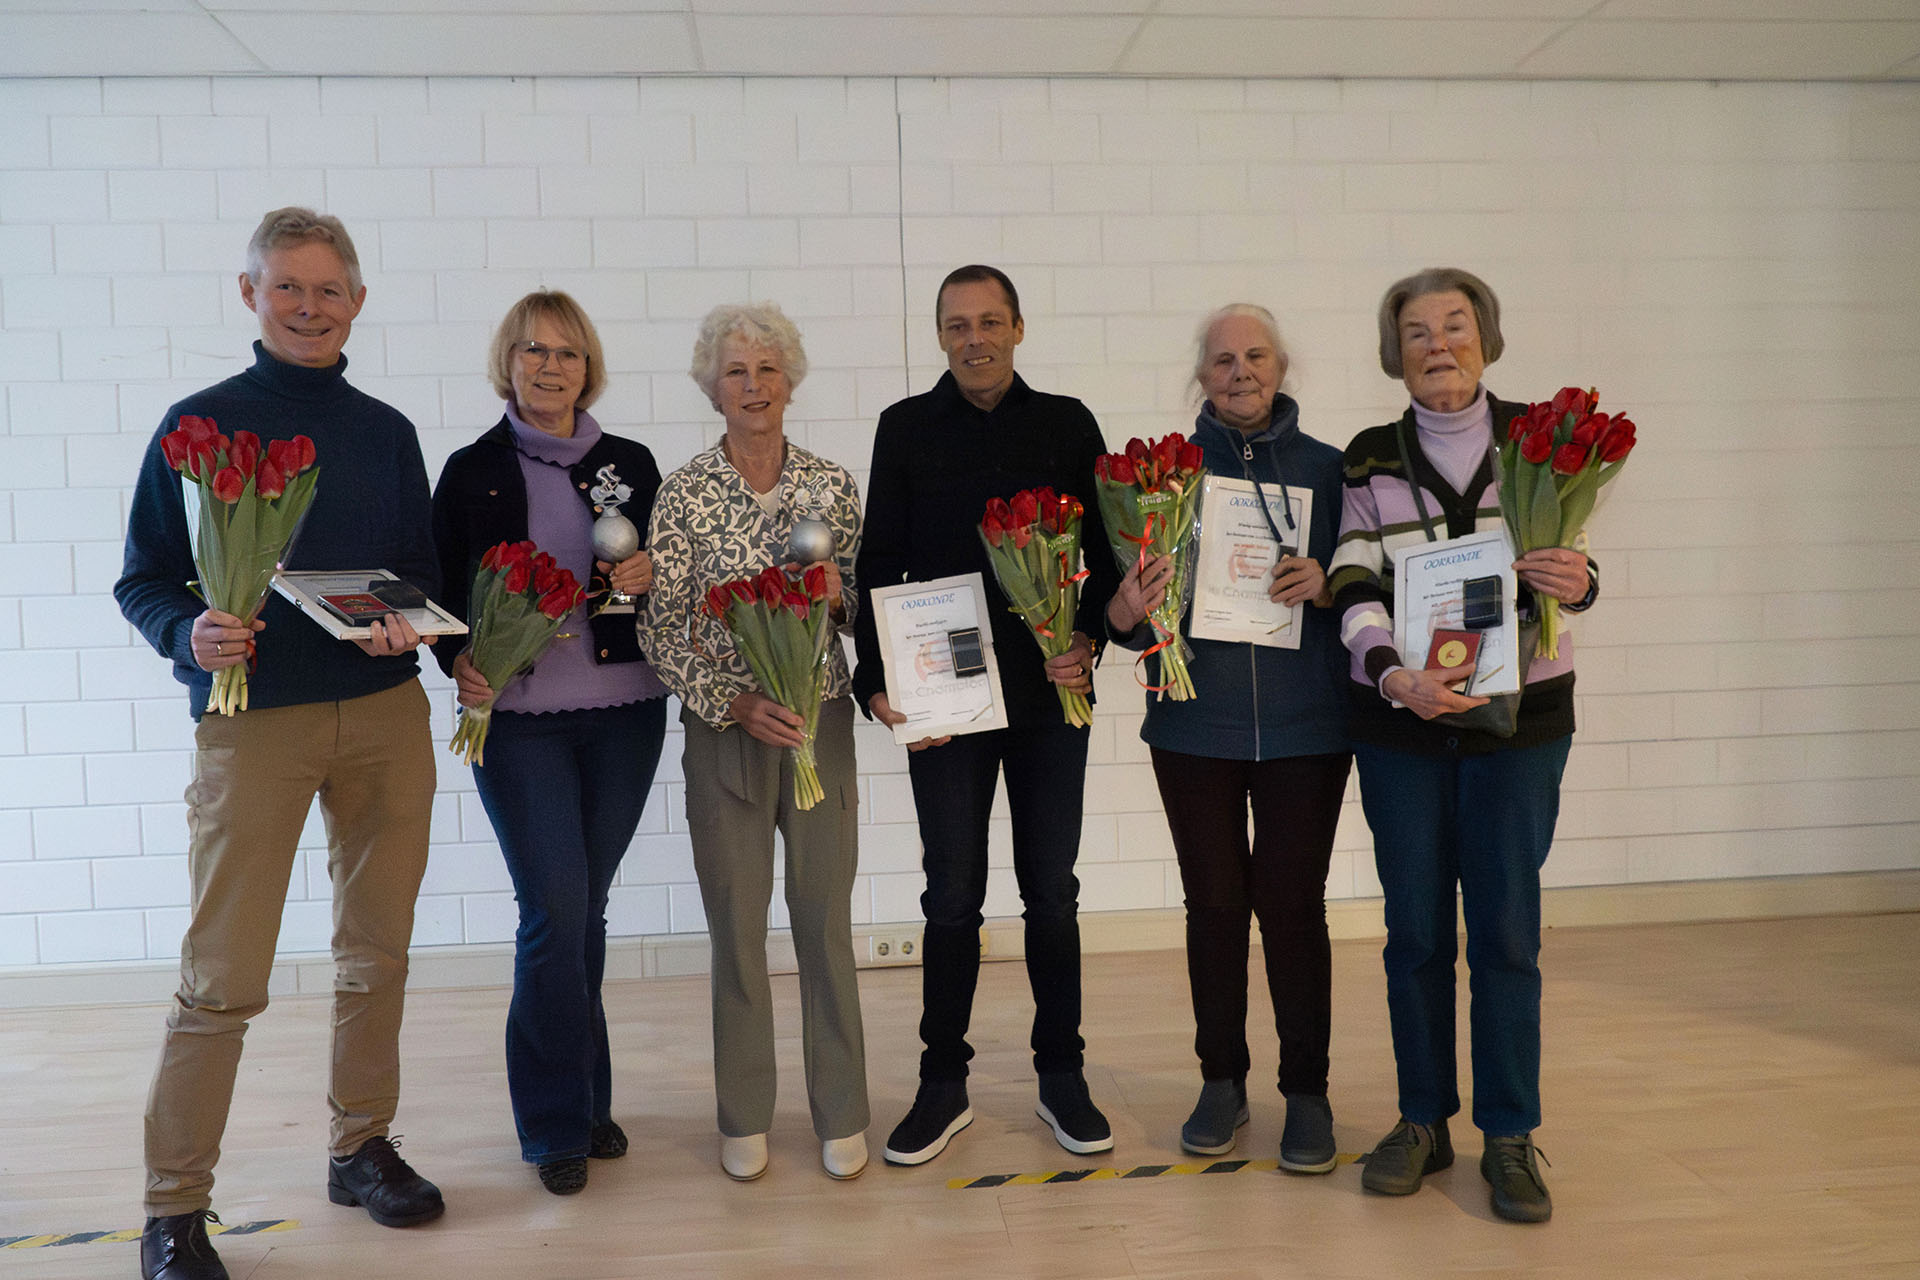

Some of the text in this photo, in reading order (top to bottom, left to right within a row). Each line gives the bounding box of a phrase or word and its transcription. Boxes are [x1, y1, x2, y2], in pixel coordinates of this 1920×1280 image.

[1229, 496, 1283, 511] OORKODE
[1424, 549, 1483, 570] OORKONDE
[901, 593, 956, 610] OORKONDE
